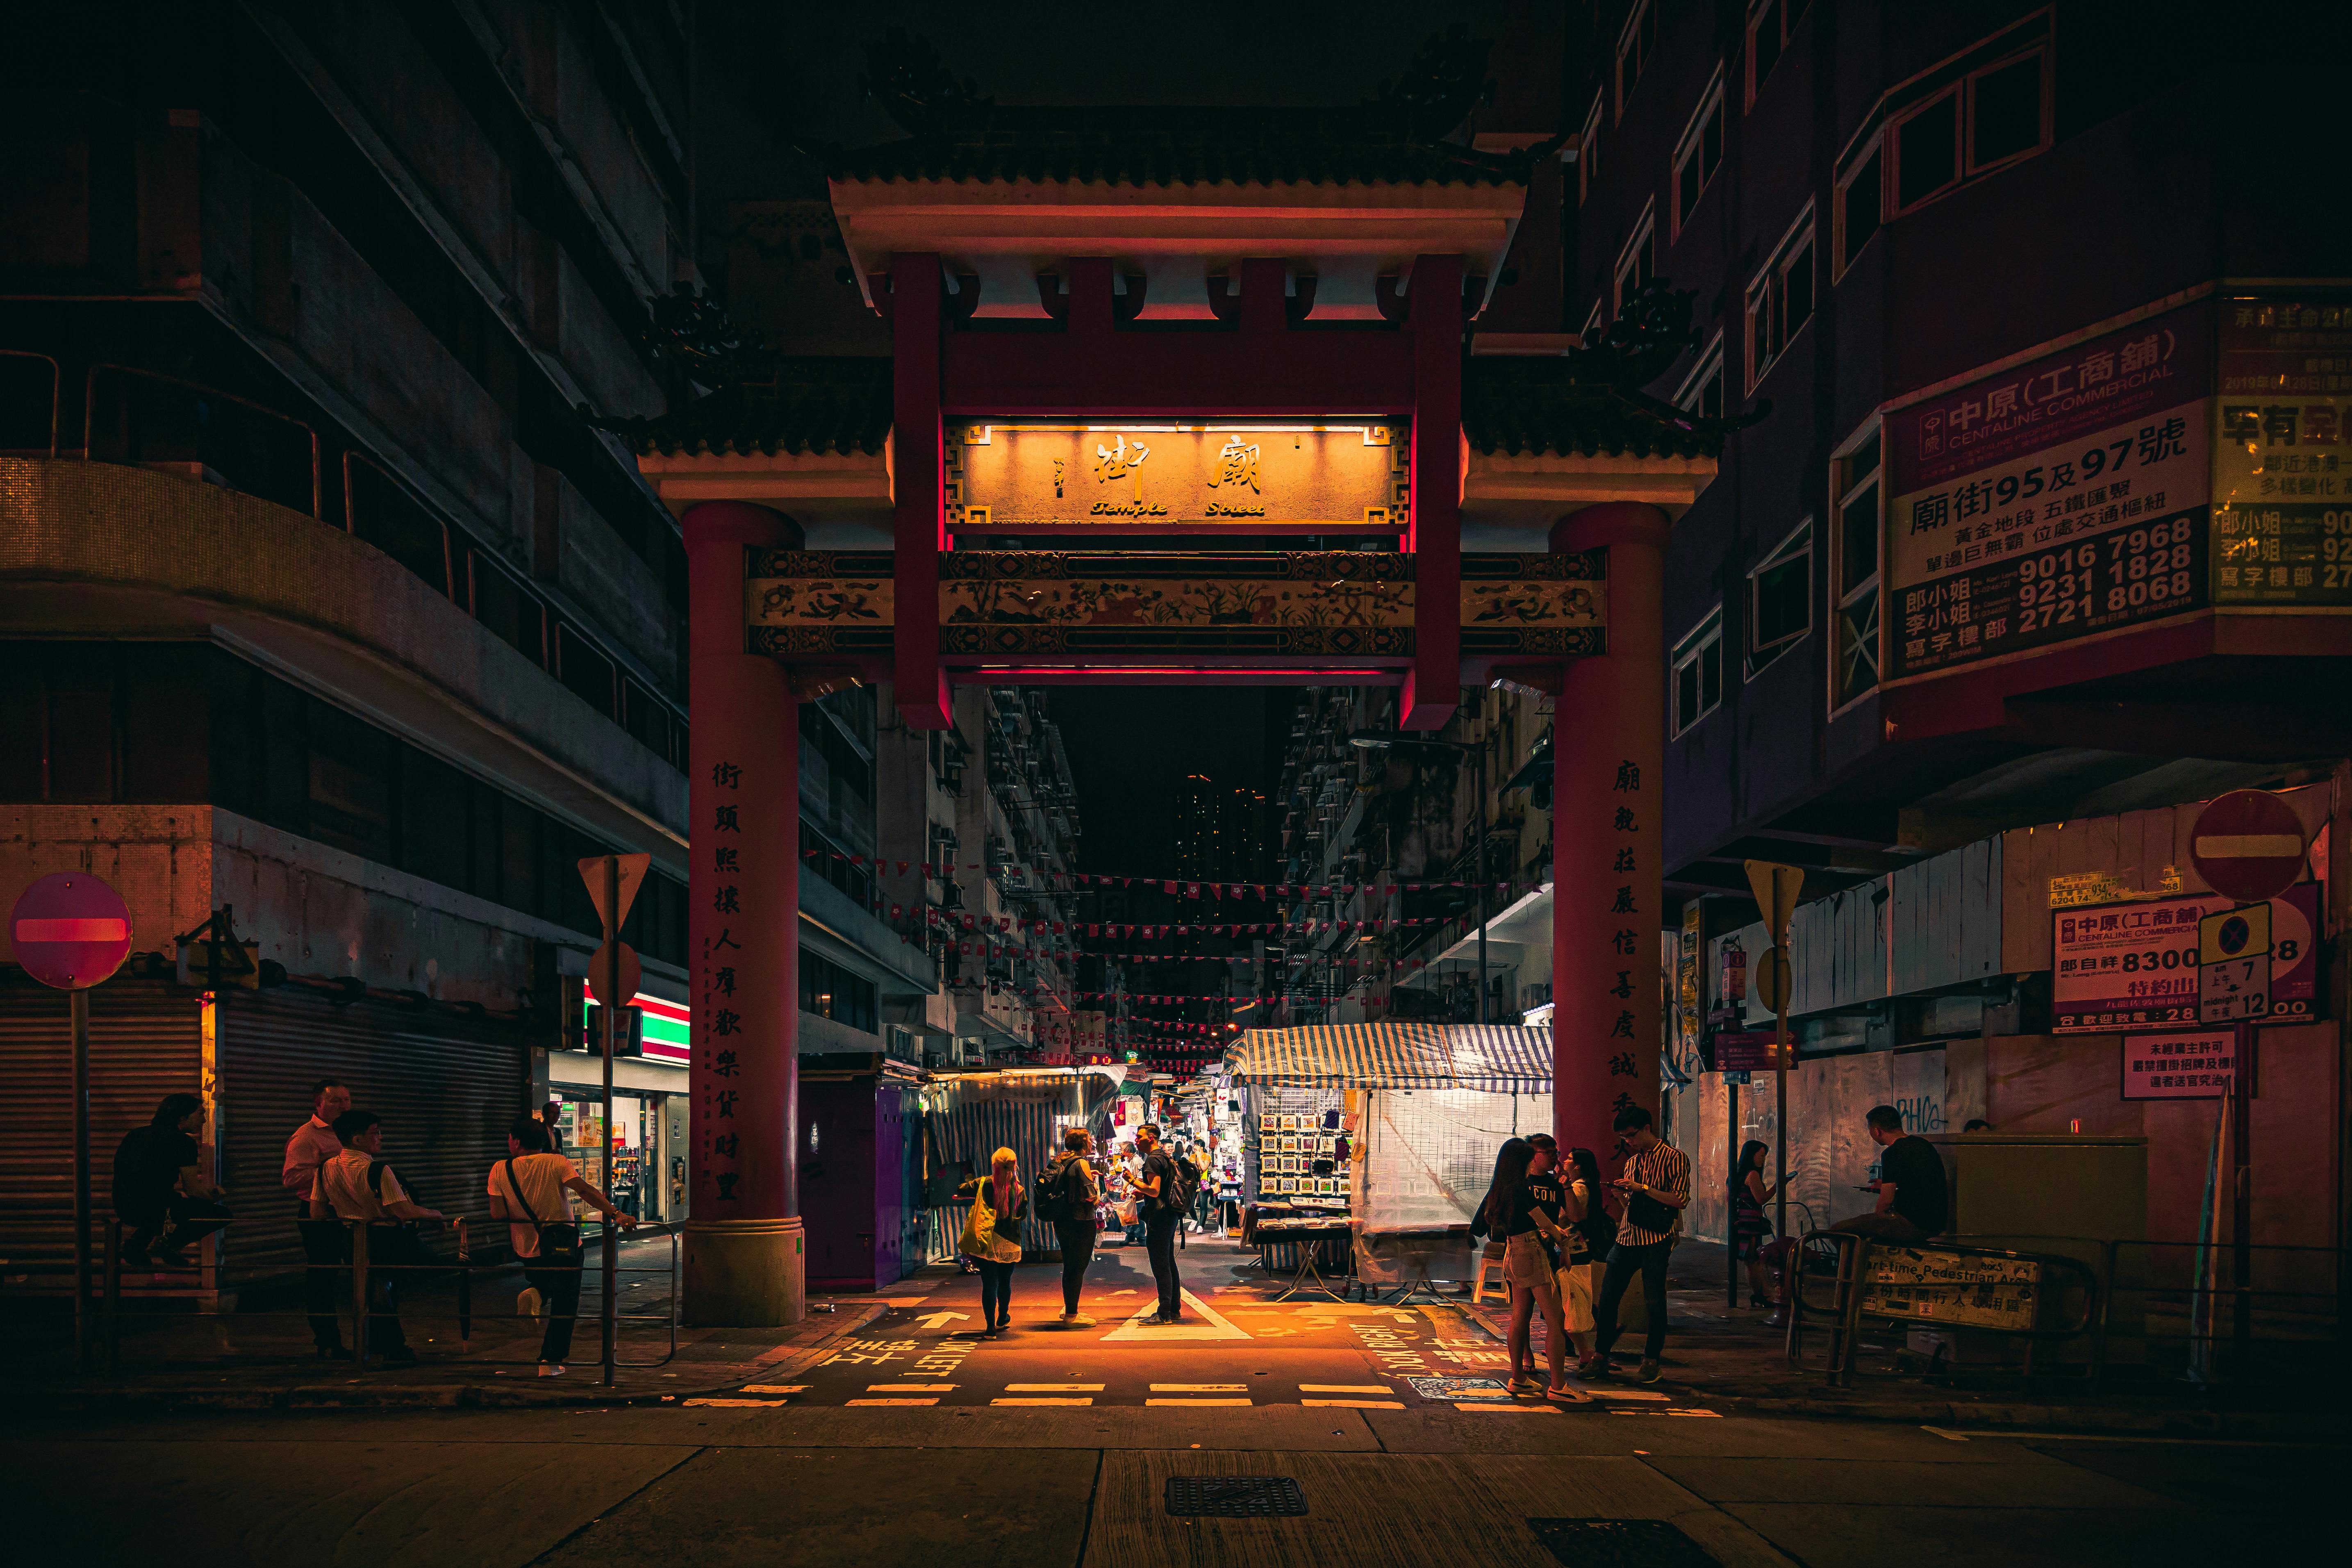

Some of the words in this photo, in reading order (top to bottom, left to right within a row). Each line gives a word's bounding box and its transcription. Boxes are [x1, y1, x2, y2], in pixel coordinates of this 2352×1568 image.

[1949, 329, 2175, 431] 中原(工商舖)
[1949, 407, 2043, 449] CENTALINE
[2047, 365, 2174, 416] COMMERCIAL
[1911, 417, 2186, 536] 廟街95及97號
[1091, 500, 1168, 518] Temple
[1205, 500, 1265, 517] Street
[1955, 509, 2035, 546] 黃金地段
[2044, 479, 2130, 520] 五鐵匯聚
[1926, 530, 2024, 573] 單邊巨無霸
[2032, 492, 2166, 544] 位處交通樞紐
[1906, 578, 1971, 614] 郎小姐
[2019, 543, 2096, 583] 9016
[2108, 518, 2191, 560] 7968
[1906, 601, 1971, 636] 李小姐
[2019, 568, 2092, 608] 9231
[2108, 544, 2191, 584] 1828
[1906, 617, 2007, 658] 寫字樓部
[2019, 594, 2091, 633] 2721
[2107, 571, 2191, 611] 8068
[2052, 897, 2074, 905] 6204
[2079, 906, 2206, 932] 中原(工商舖)
[2079, 930, 2132, 942] CENTALINE
[2061, 956, 2118, 972] 郎自祥
[2122, 948, 2198, 972] 8300
[2242, 961, 2254, 981] 7
[2212, 974, 2230, 987] 上午
[2166, 1008, 2195, 1021] 28
[2274, 1001, 2307, 1015] 00
[2204, 994, 2238, 1006] midnight
[2243, 993, 2264, 1014] 12
[2211, 1007, 2231, 1018] 午夜
[2150, 1040, 2223, 1055] 未經業主許可
[2150, 1074, 2224, 1088] 違者送官究治
[1868, 1260, 1918, 1274] art-time
[1923, 1265, 1994, 1284] Pedestrian
[1349, 1324, 1409, 1348] RIGHT
[903, 1355, 967, 1377] LEFT
